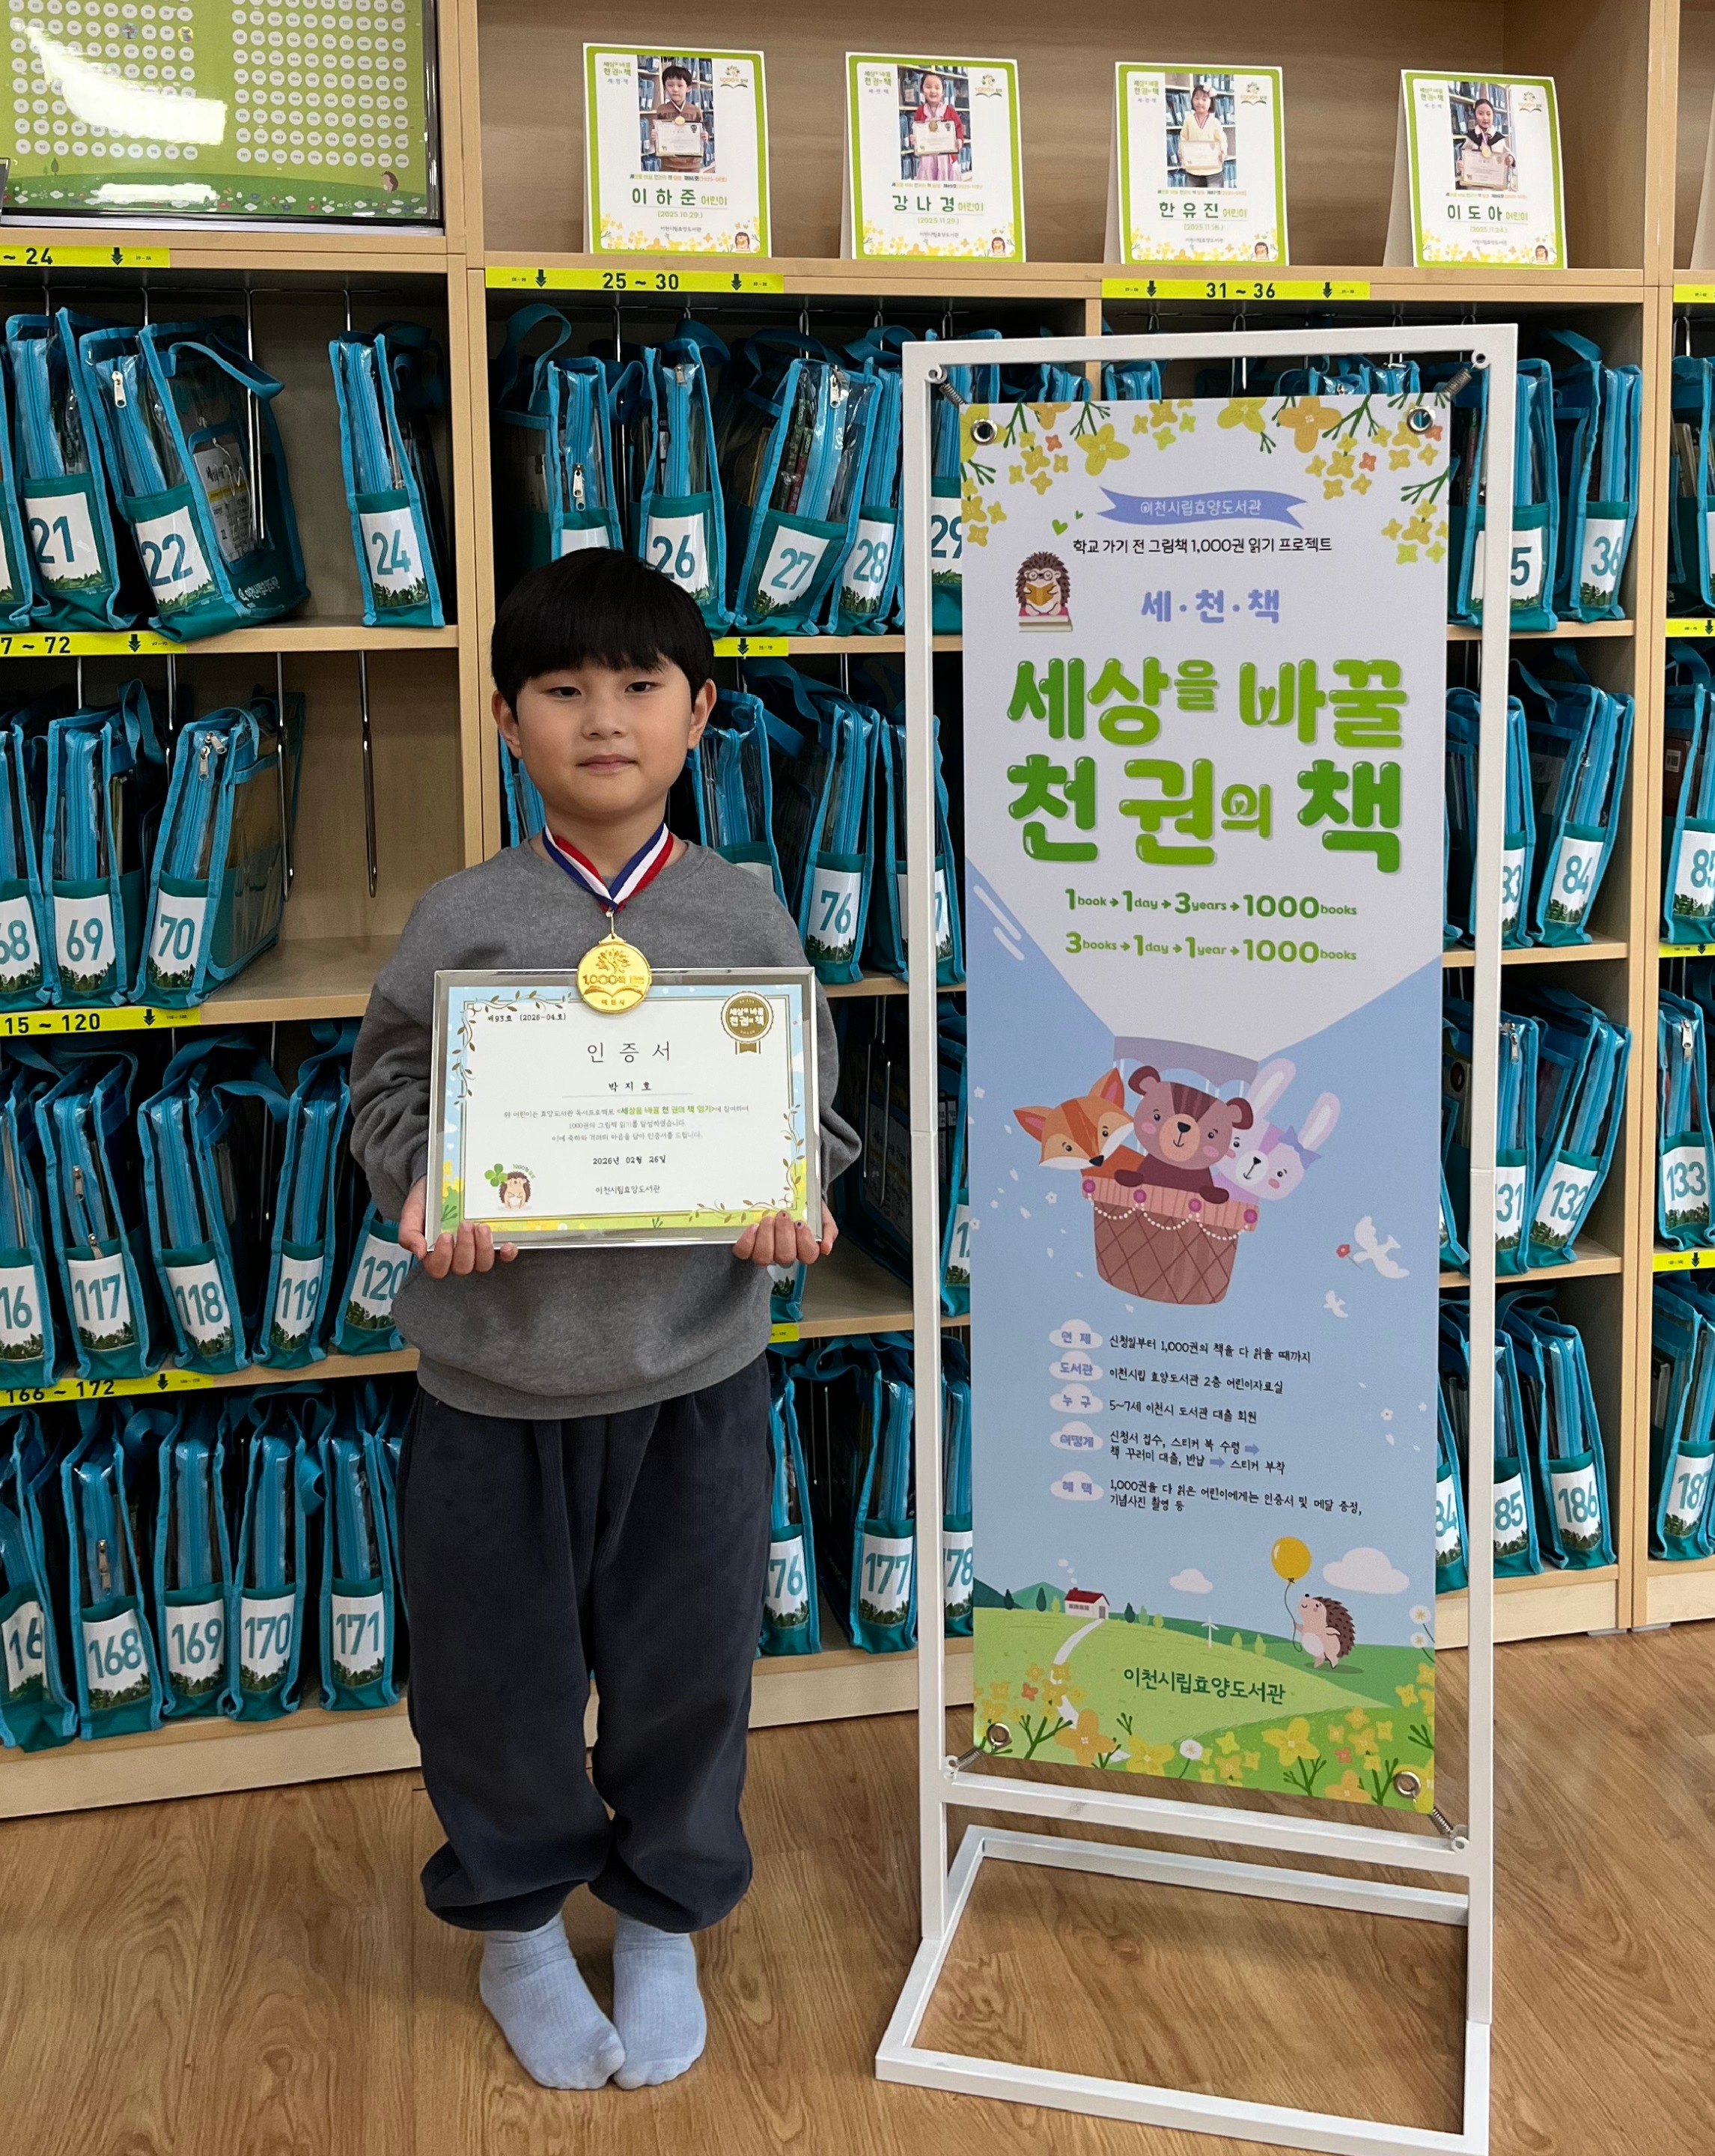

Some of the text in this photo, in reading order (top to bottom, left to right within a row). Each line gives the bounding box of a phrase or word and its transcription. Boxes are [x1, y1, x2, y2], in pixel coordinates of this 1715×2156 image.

[701, 195, 728, 206] 어린이
[26, 248, 53, 265] 24
[602, 272, 680, 290] 25 30
[1206, 282, 1275, 299] 31 36
[1140, 499, 1262, 517] 이천시립효양도서관
[30, 515, 75, 564] 21
[141, 533, 192, 586] 22
[371, 529, 411, 575] 24
[653, 535, 695, 579] 26
[1073, 537, 1332, 554] 학교 가기 전 그림책 1,000권 읽기 프로젝트
[771, 546, 816, 591] 27
[853, 538, 887, 582] 28
[44, 636, 70, 654] 72
[1006, 656, 1409, 749] 세상을 바꿀
[1006, 753, 1403, 874] 천 권의 책
[1562, 855, 1593, 895] 84
[820, 890, 852, 934] 76
[66, 916, 103, 961] 69
[158, 916, 195, 960] 70
[61, 1013, 101, 1032] 120
[593, 1156, 619, 1165] 2026년
[648, 1154, 666, 1164] 26일
[595, 1185, 661, 1196] 이천시립효양도서관
[1666, 1161, 1706, 1201] 133
[1494, 1183, 1523, 1222] 31
[75, 1273, 121, 1321] 117
[281, 1276, 320, 1321] 119
[362, 1257, 407, 1301] 120
[175, 1281, 224, 1327] 118
[1109, 1334, 1311, 1363] 신청일부터 1,000권의 책을 다 읽을 때까지
[76, 1380, 115, 1398] 172
[1060, 1362, 1093, 1376] 도서관
[1109, 1367, 1283, 1394] 이천시립 효양도서관 2층 어린이자료실
[1109, 1400, 1257, 1425] 5~7세 이천시 도서관 대출 회원
[1060, 1434, 1094, 1448] 어떻게
[1109, 1430, 1240, 1455] 신청서 접수, 스티커 북 수령
[1110, 1445, 1285, 1476] 책 꾸러미 대출, 반납 스티커 부착
[1110, 1479, 1362, 1516] 1,000권을 다 읽은 어린이에게는 인증서 및 메달 증정,
[1110, 1493, 1185, 1512] 기념사진 촬영 등
[1558, 1480, 1598, 1523] 186
[765, 1555, 802, 1598] 76
[865, 1553, 910, 1595] 177
[944, 1547, 973, 1587] 78
[88, 1627, 142, 1679] 168
[171, 1618, 222, 1665] 169
[244, 1613, 292, 1660] 170
[335, 1611, 380, 1656] 171
[1123, 1666, 1287, 1706] 이천시립효양도서관
